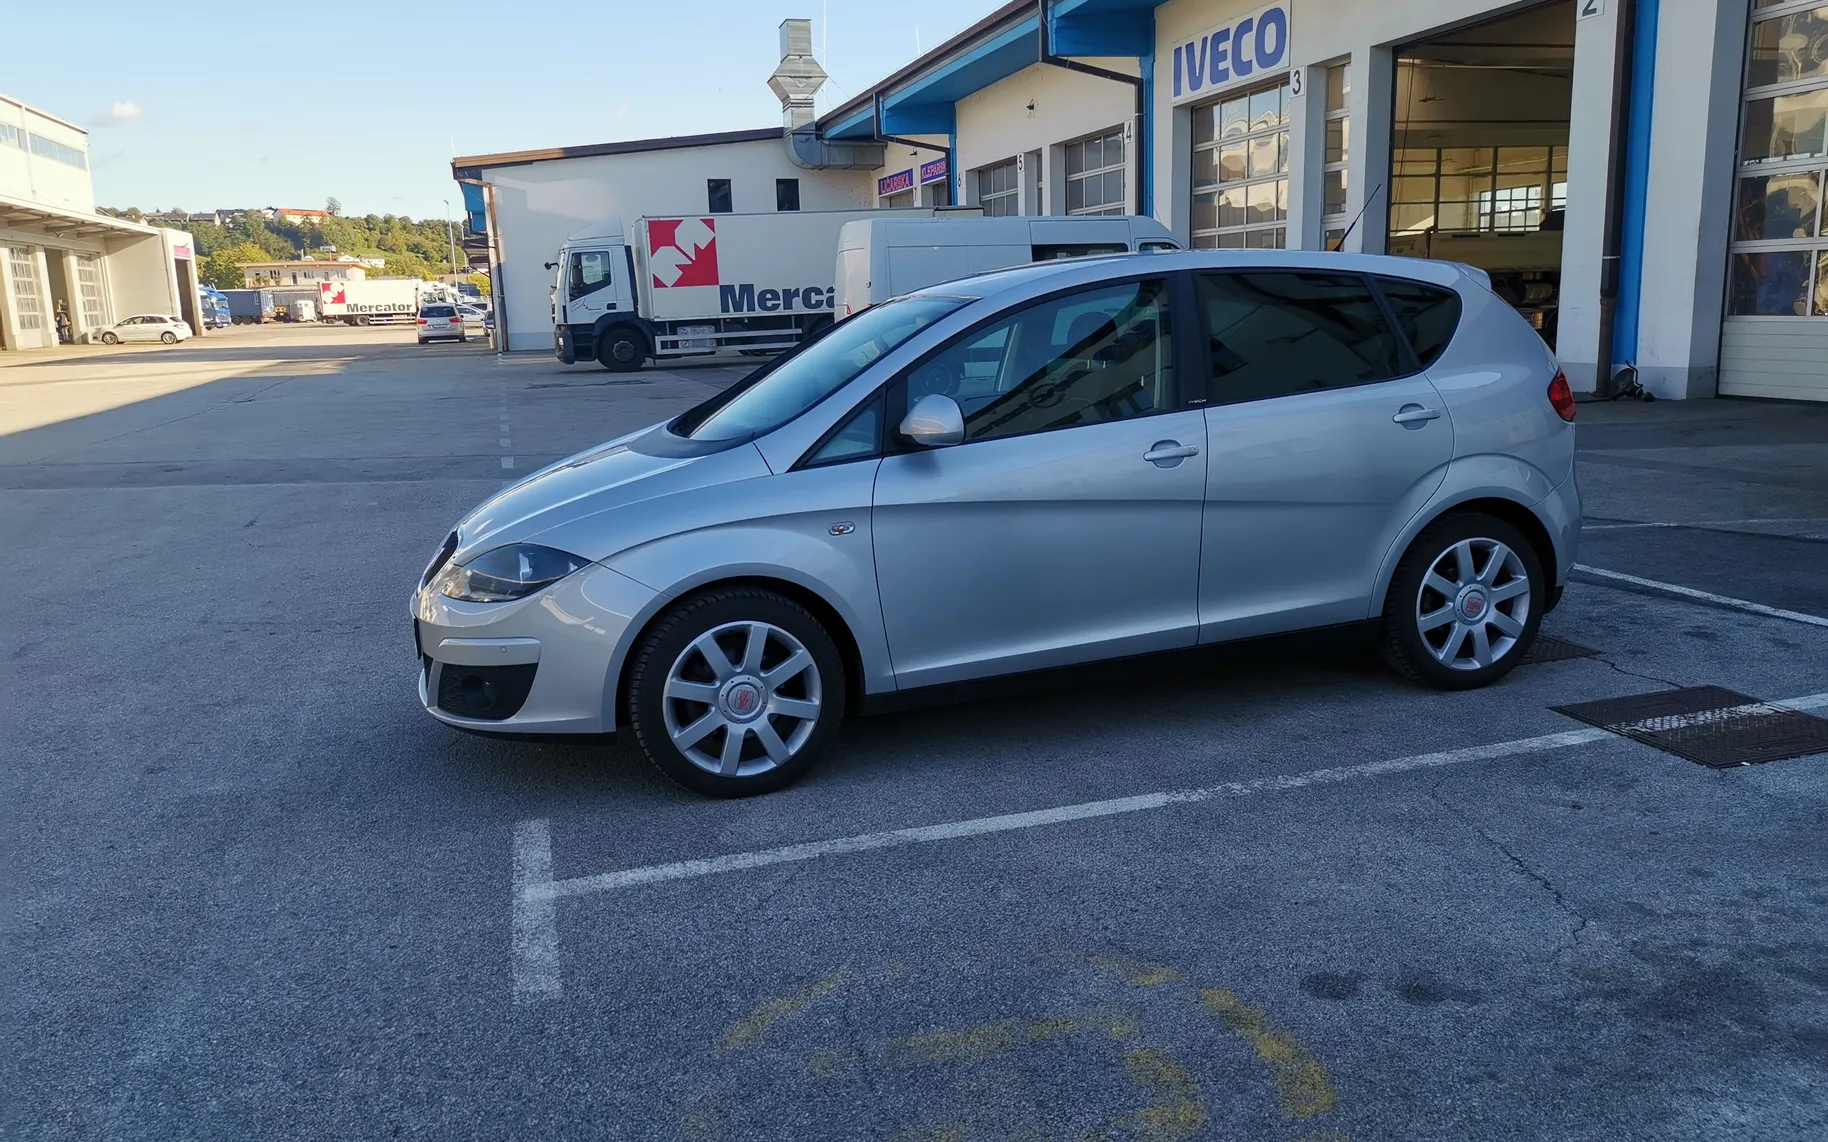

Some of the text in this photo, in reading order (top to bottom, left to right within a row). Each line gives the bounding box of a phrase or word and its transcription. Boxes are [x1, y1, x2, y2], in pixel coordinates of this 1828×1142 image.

[1173, 7, 1287, 98] IVECO
[1292, 70, 1301, 95] 3
[1126, 122, 1132, 142] 4
[1018, 154, 1023, 171] 5
[347, 303, 413, 313] Mercator
